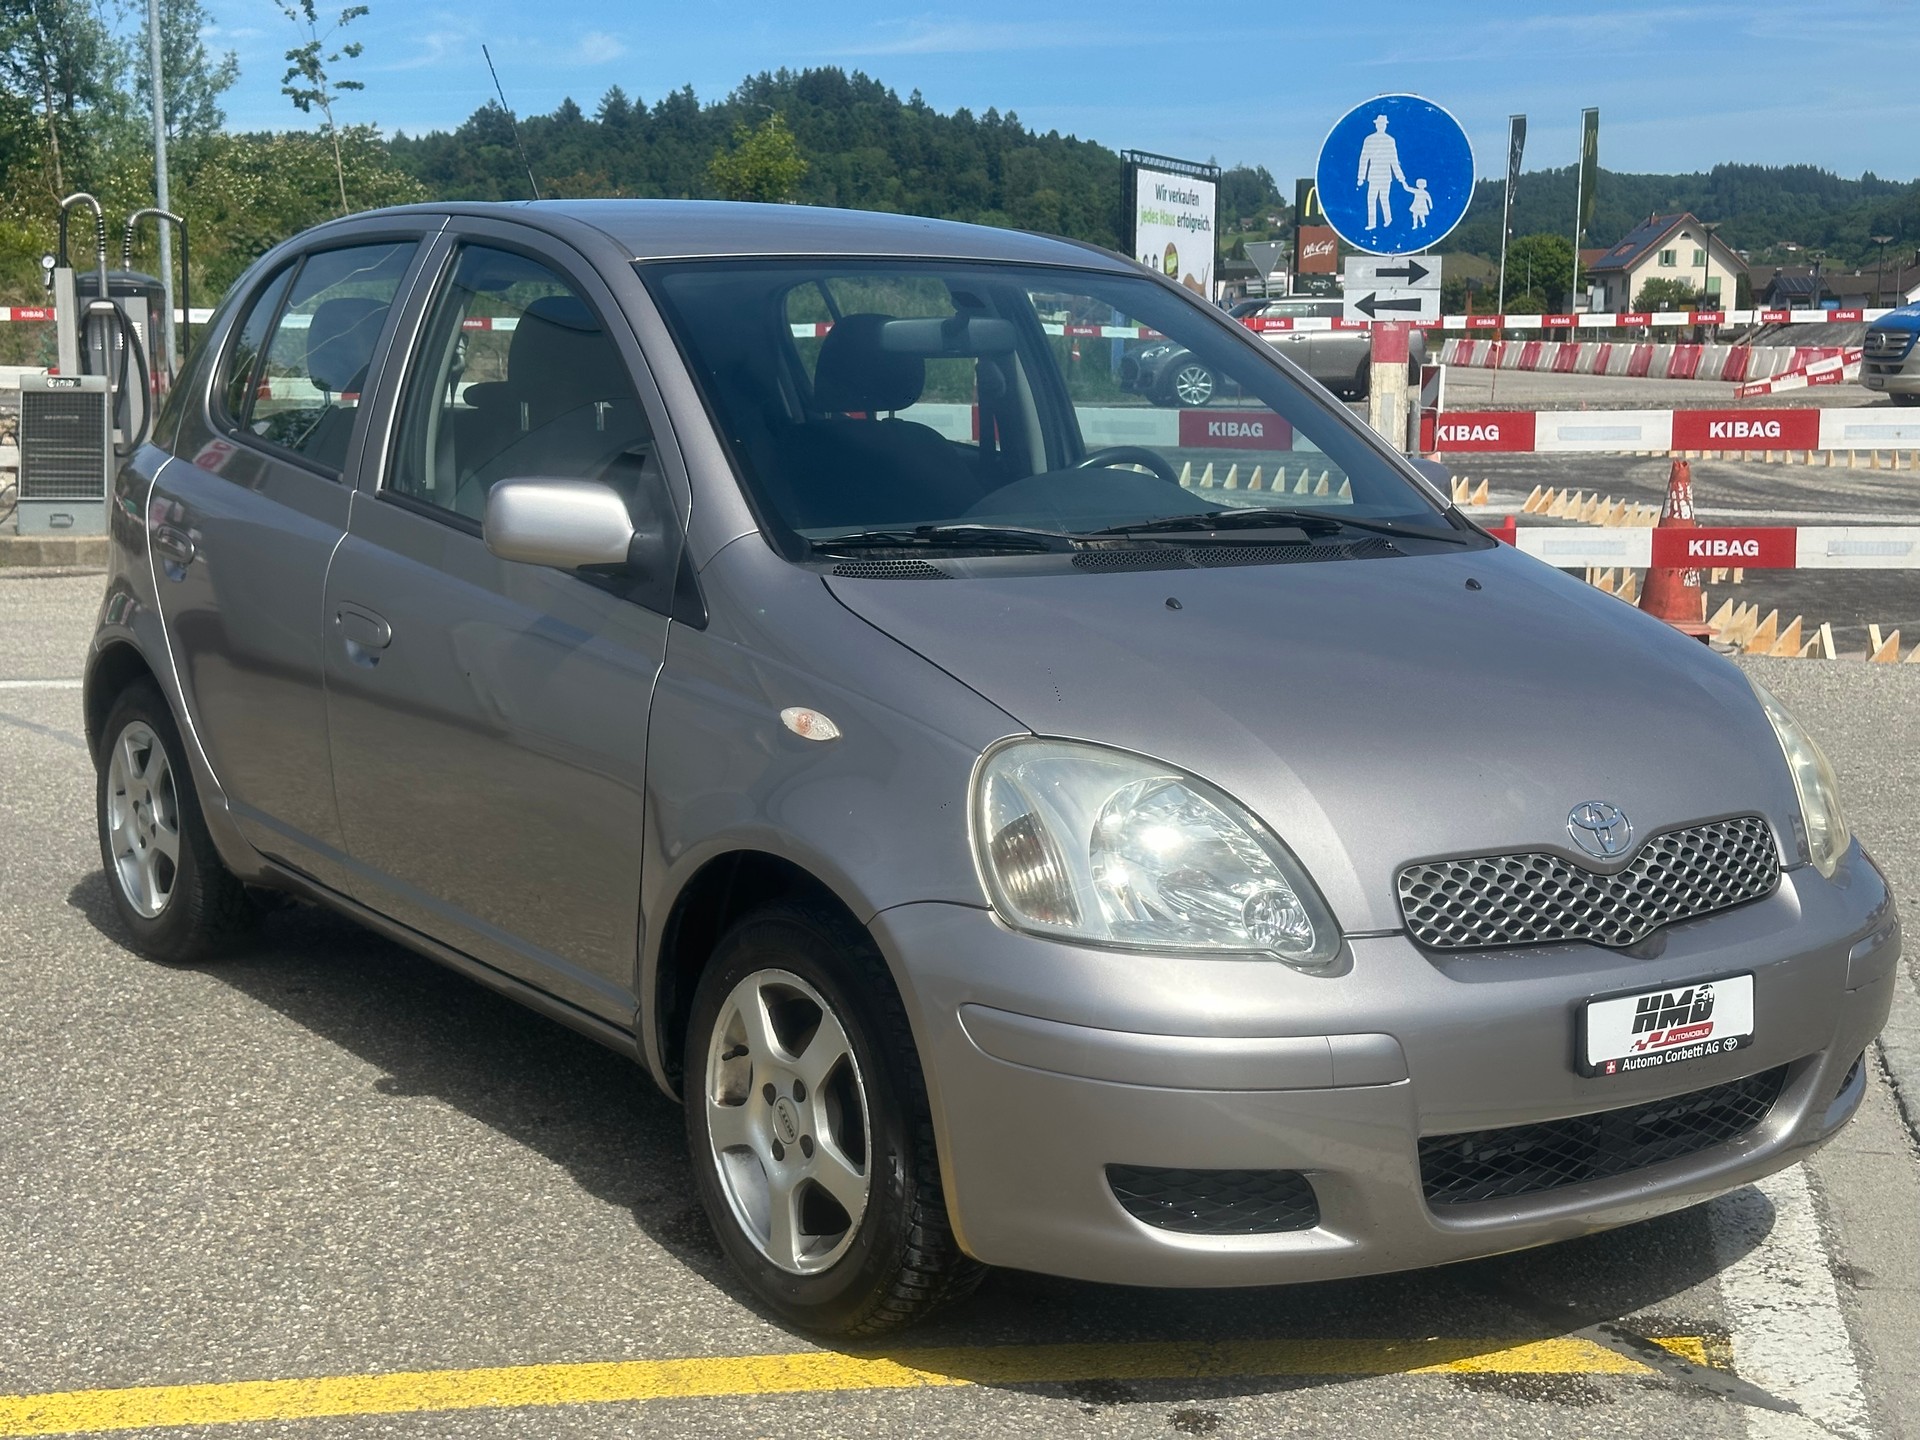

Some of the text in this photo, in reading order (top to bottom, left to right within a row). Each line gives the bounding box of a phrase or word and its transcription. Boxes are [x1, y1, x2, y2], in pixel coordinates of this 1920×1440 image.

[1155, 183, 1200, 207] Wir verkaufen
[1140, 205, 1212, 233] jedes Haus erfolgreich.
[1476, 318, 1496, 326] KIBAG
[1550, 317, 1570, 325] KIBAG
[1697, 314, 1717, 322] KIBAG
[1763, 313, 1783, 321] KIBAG
[1816, 372, 1835, 382] KIBAG
[1208, 421, 1264, 438] KIBAG
[1436, 424, 1500, 442] KIBAG
[1709, 420, 1781, 439] KIBAG
[1688, 539, 1760, 557] KIBAG
[1667, 1027, 1710, 1042] AUTOMOBILE
[1622, 1040, 1720, 1071] Automo Corbetti AG
